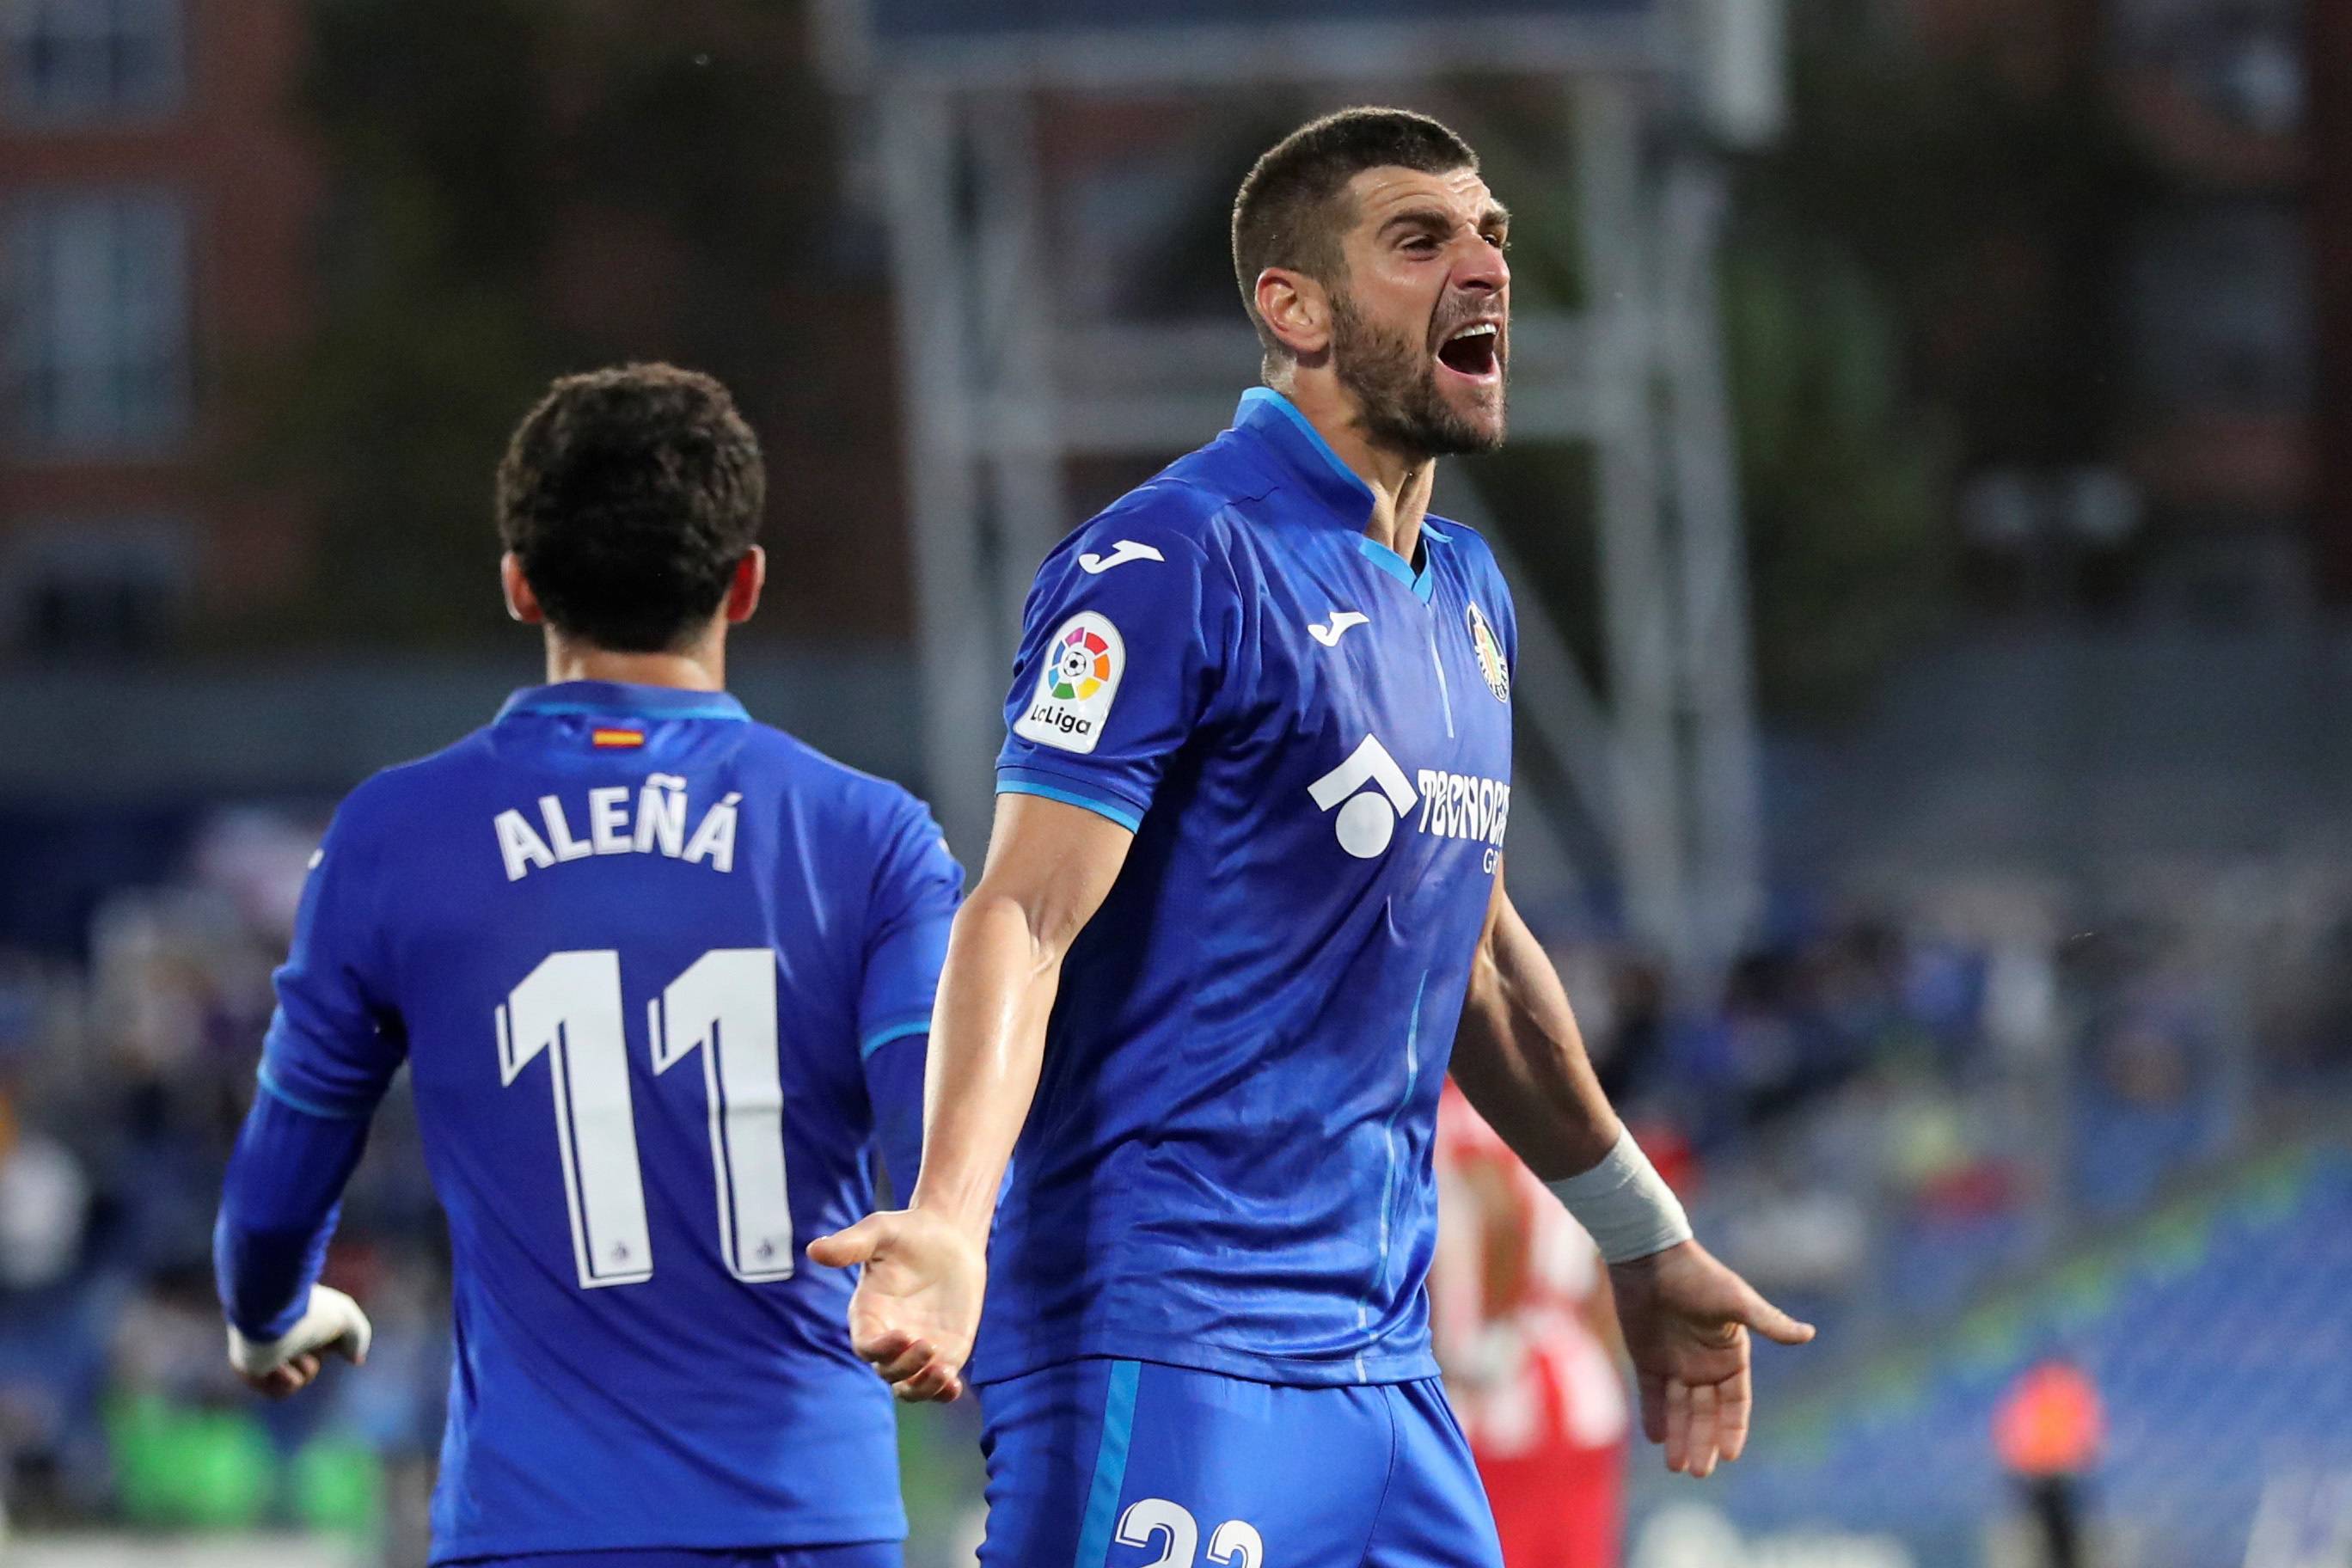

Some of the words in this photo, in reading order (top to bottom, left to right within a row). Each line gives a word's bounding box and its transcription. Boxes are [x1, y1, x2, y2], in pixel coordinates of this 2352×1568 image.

[1031, 704, 1092, 736] LaLiga
[494, 772, 743, 882] ALEÑÁ
[495, 949, 794, 1289] 11
